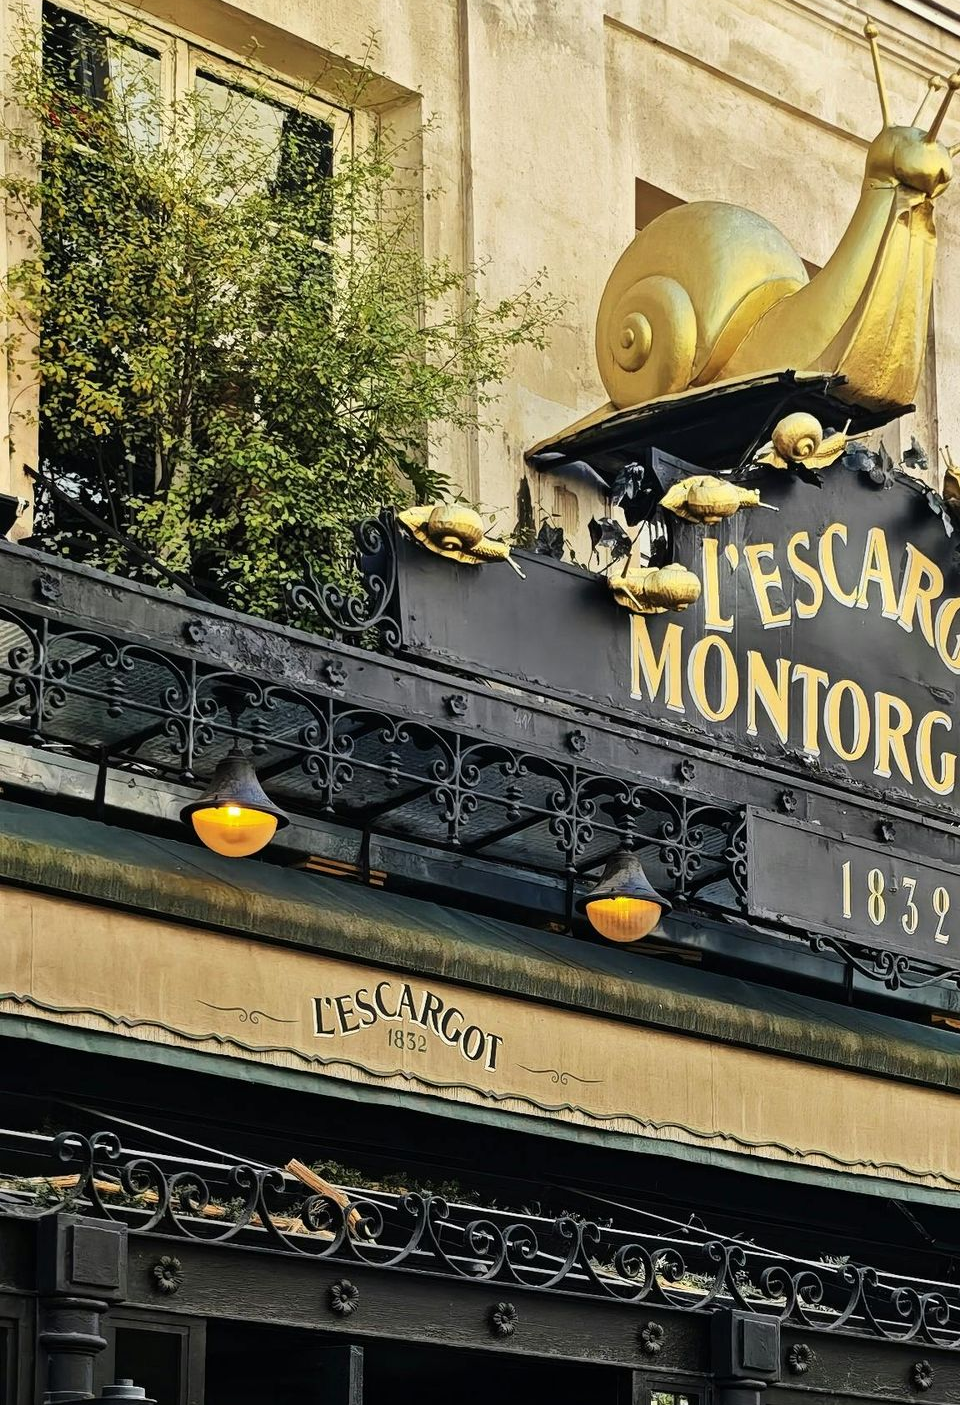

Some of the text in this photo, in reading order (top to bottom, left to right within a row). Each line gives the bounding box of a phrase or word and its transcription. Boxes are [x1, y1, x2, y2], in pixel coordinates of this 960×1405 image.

[841, 860, 951, 944] 1832
[311, 981, 503, 1073] L'ESCARGOT
[387, 1027, 428, 1053] 1832
